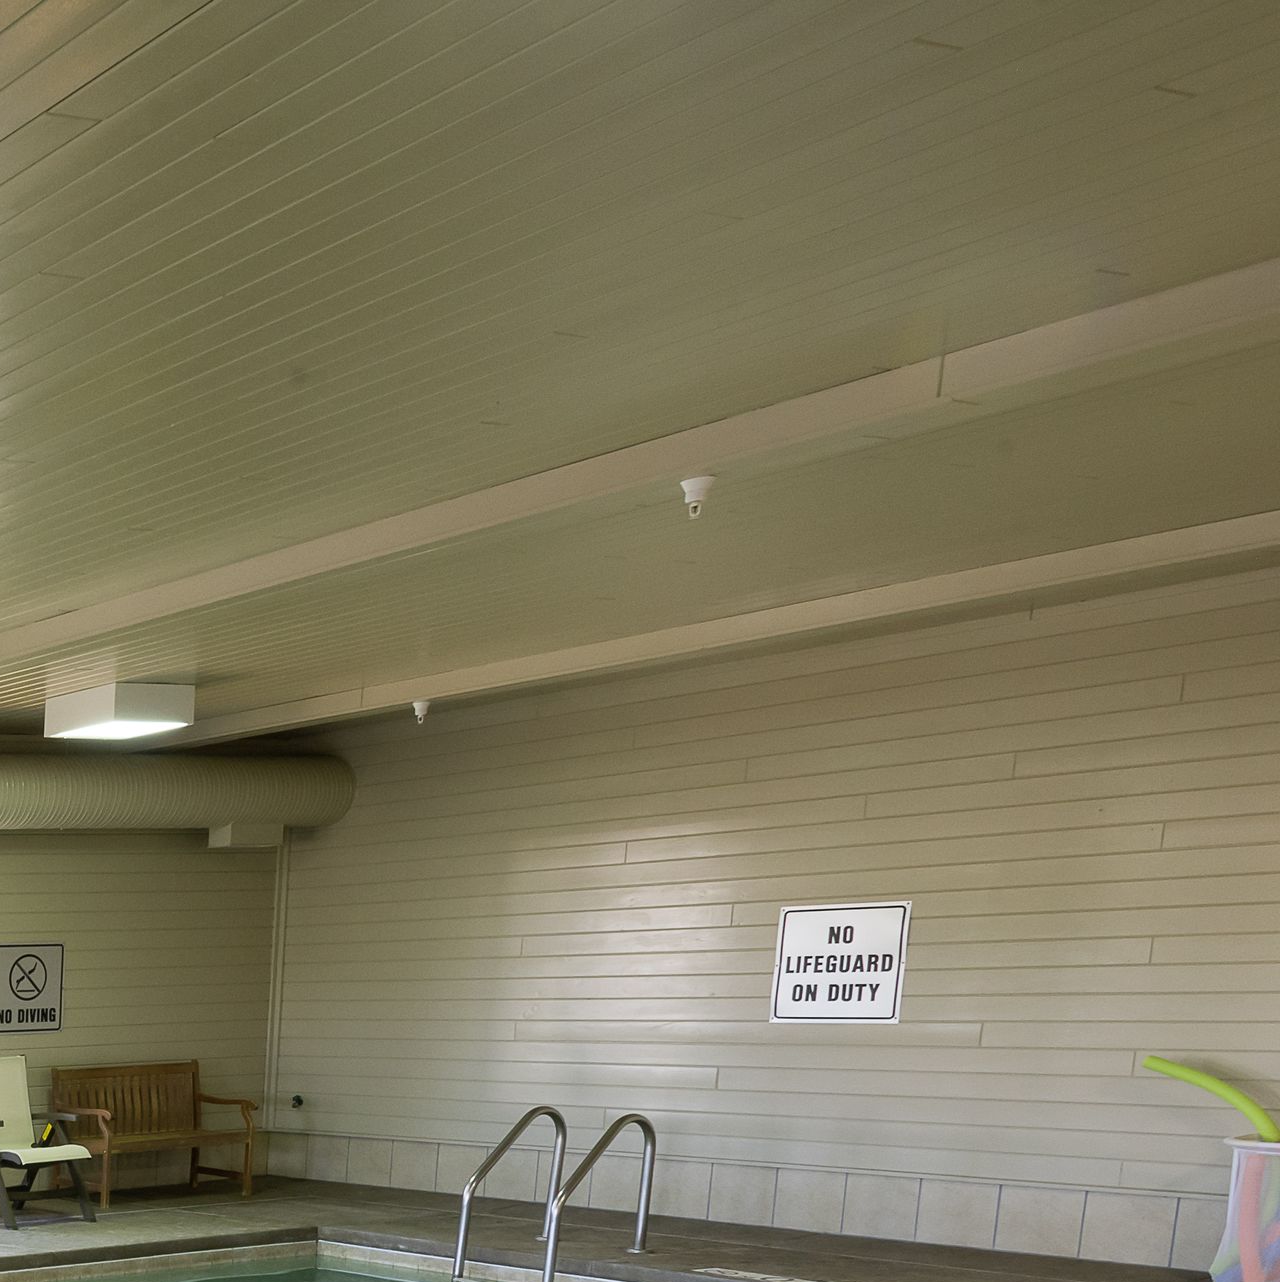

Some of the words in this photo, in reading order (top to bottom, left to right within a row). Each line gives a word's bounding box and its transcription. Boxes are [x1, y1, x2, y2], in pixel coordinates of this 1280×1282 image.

[828, 925, 854, 944] NO
[785, 954, 894, 974] LIFEGUARD
[792, 984, 818, 1002] ON
[828, 983, 881, 1002] DUTY
[17, 1008, 57, 1023] DIVING
